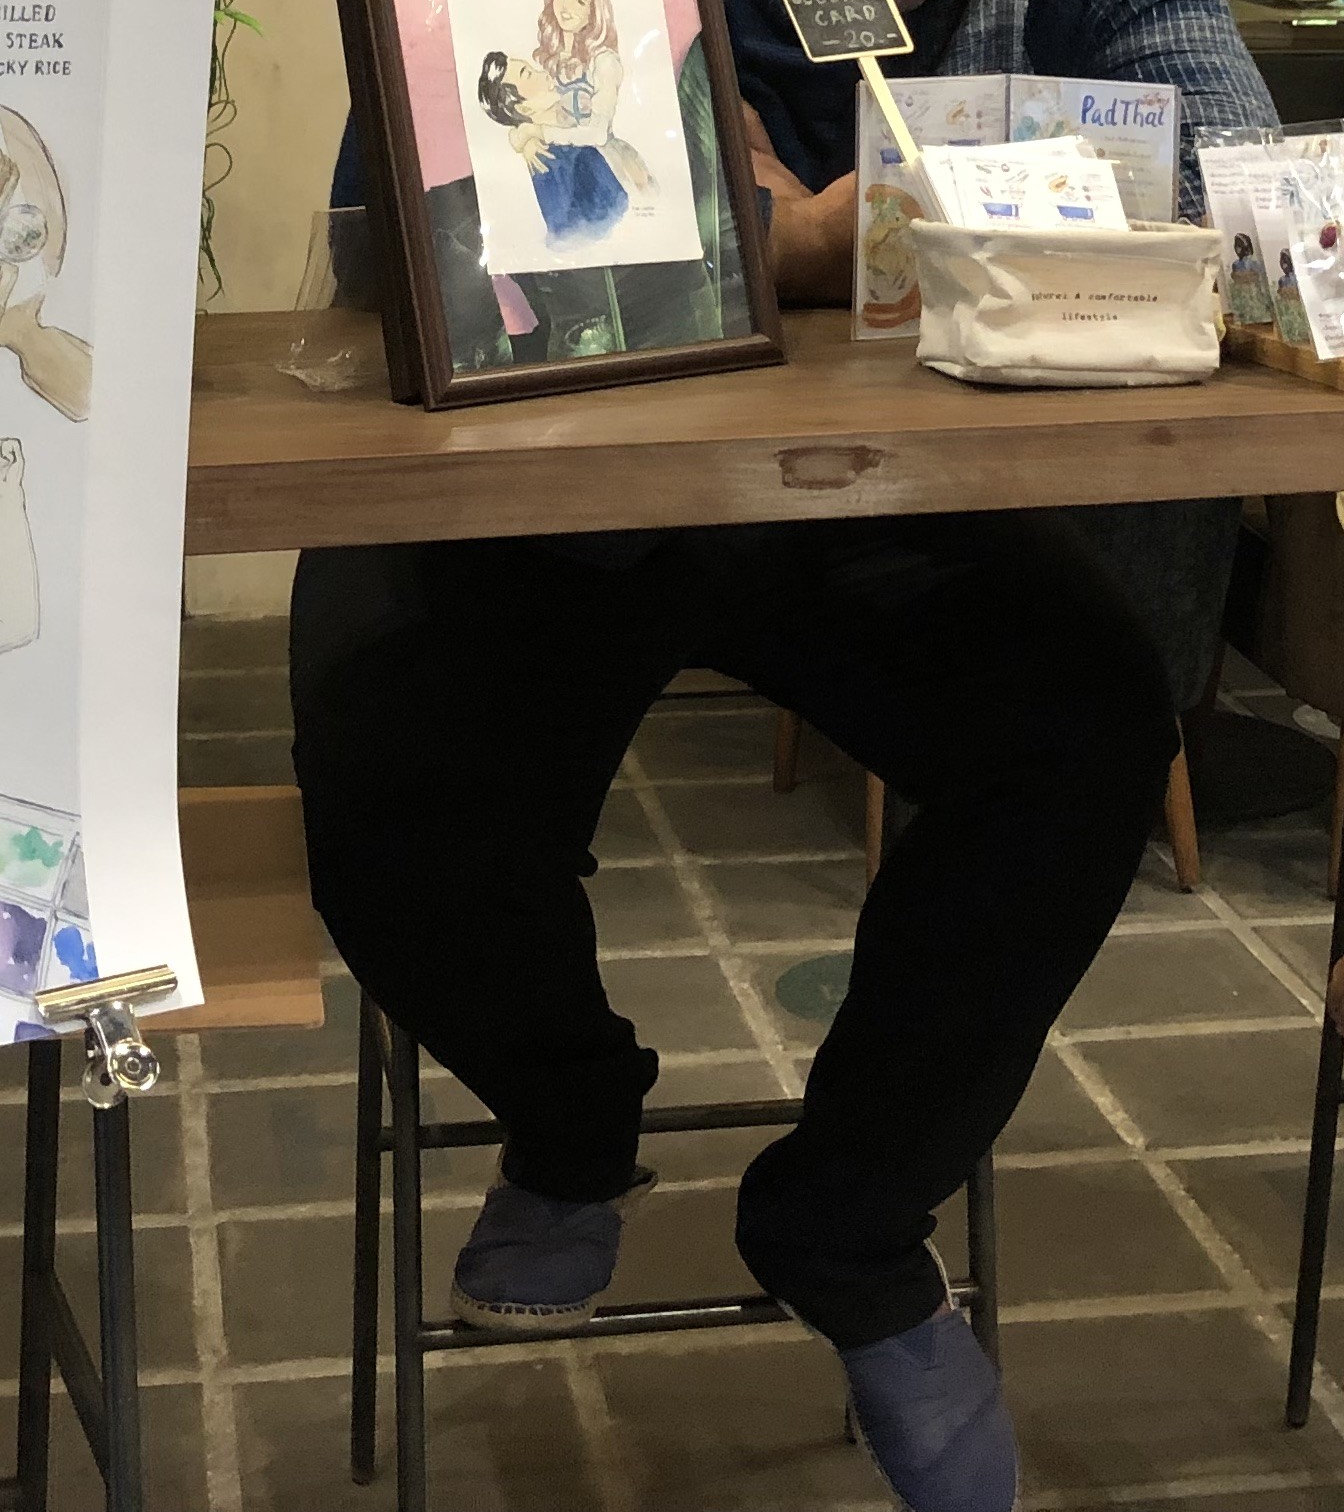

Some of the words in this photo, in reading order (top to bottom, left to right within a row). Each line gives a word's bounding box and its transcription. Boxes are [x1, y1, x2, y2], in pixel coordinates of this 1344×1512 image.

[815, 5, 876, 26] CARD
[5, 32, 64, 49] STEAK
[34, 60, 72, 76] RICE
[1088, 293, 1158, 302] comfortable
[1062, 312, 1118, 321] lifestyle
